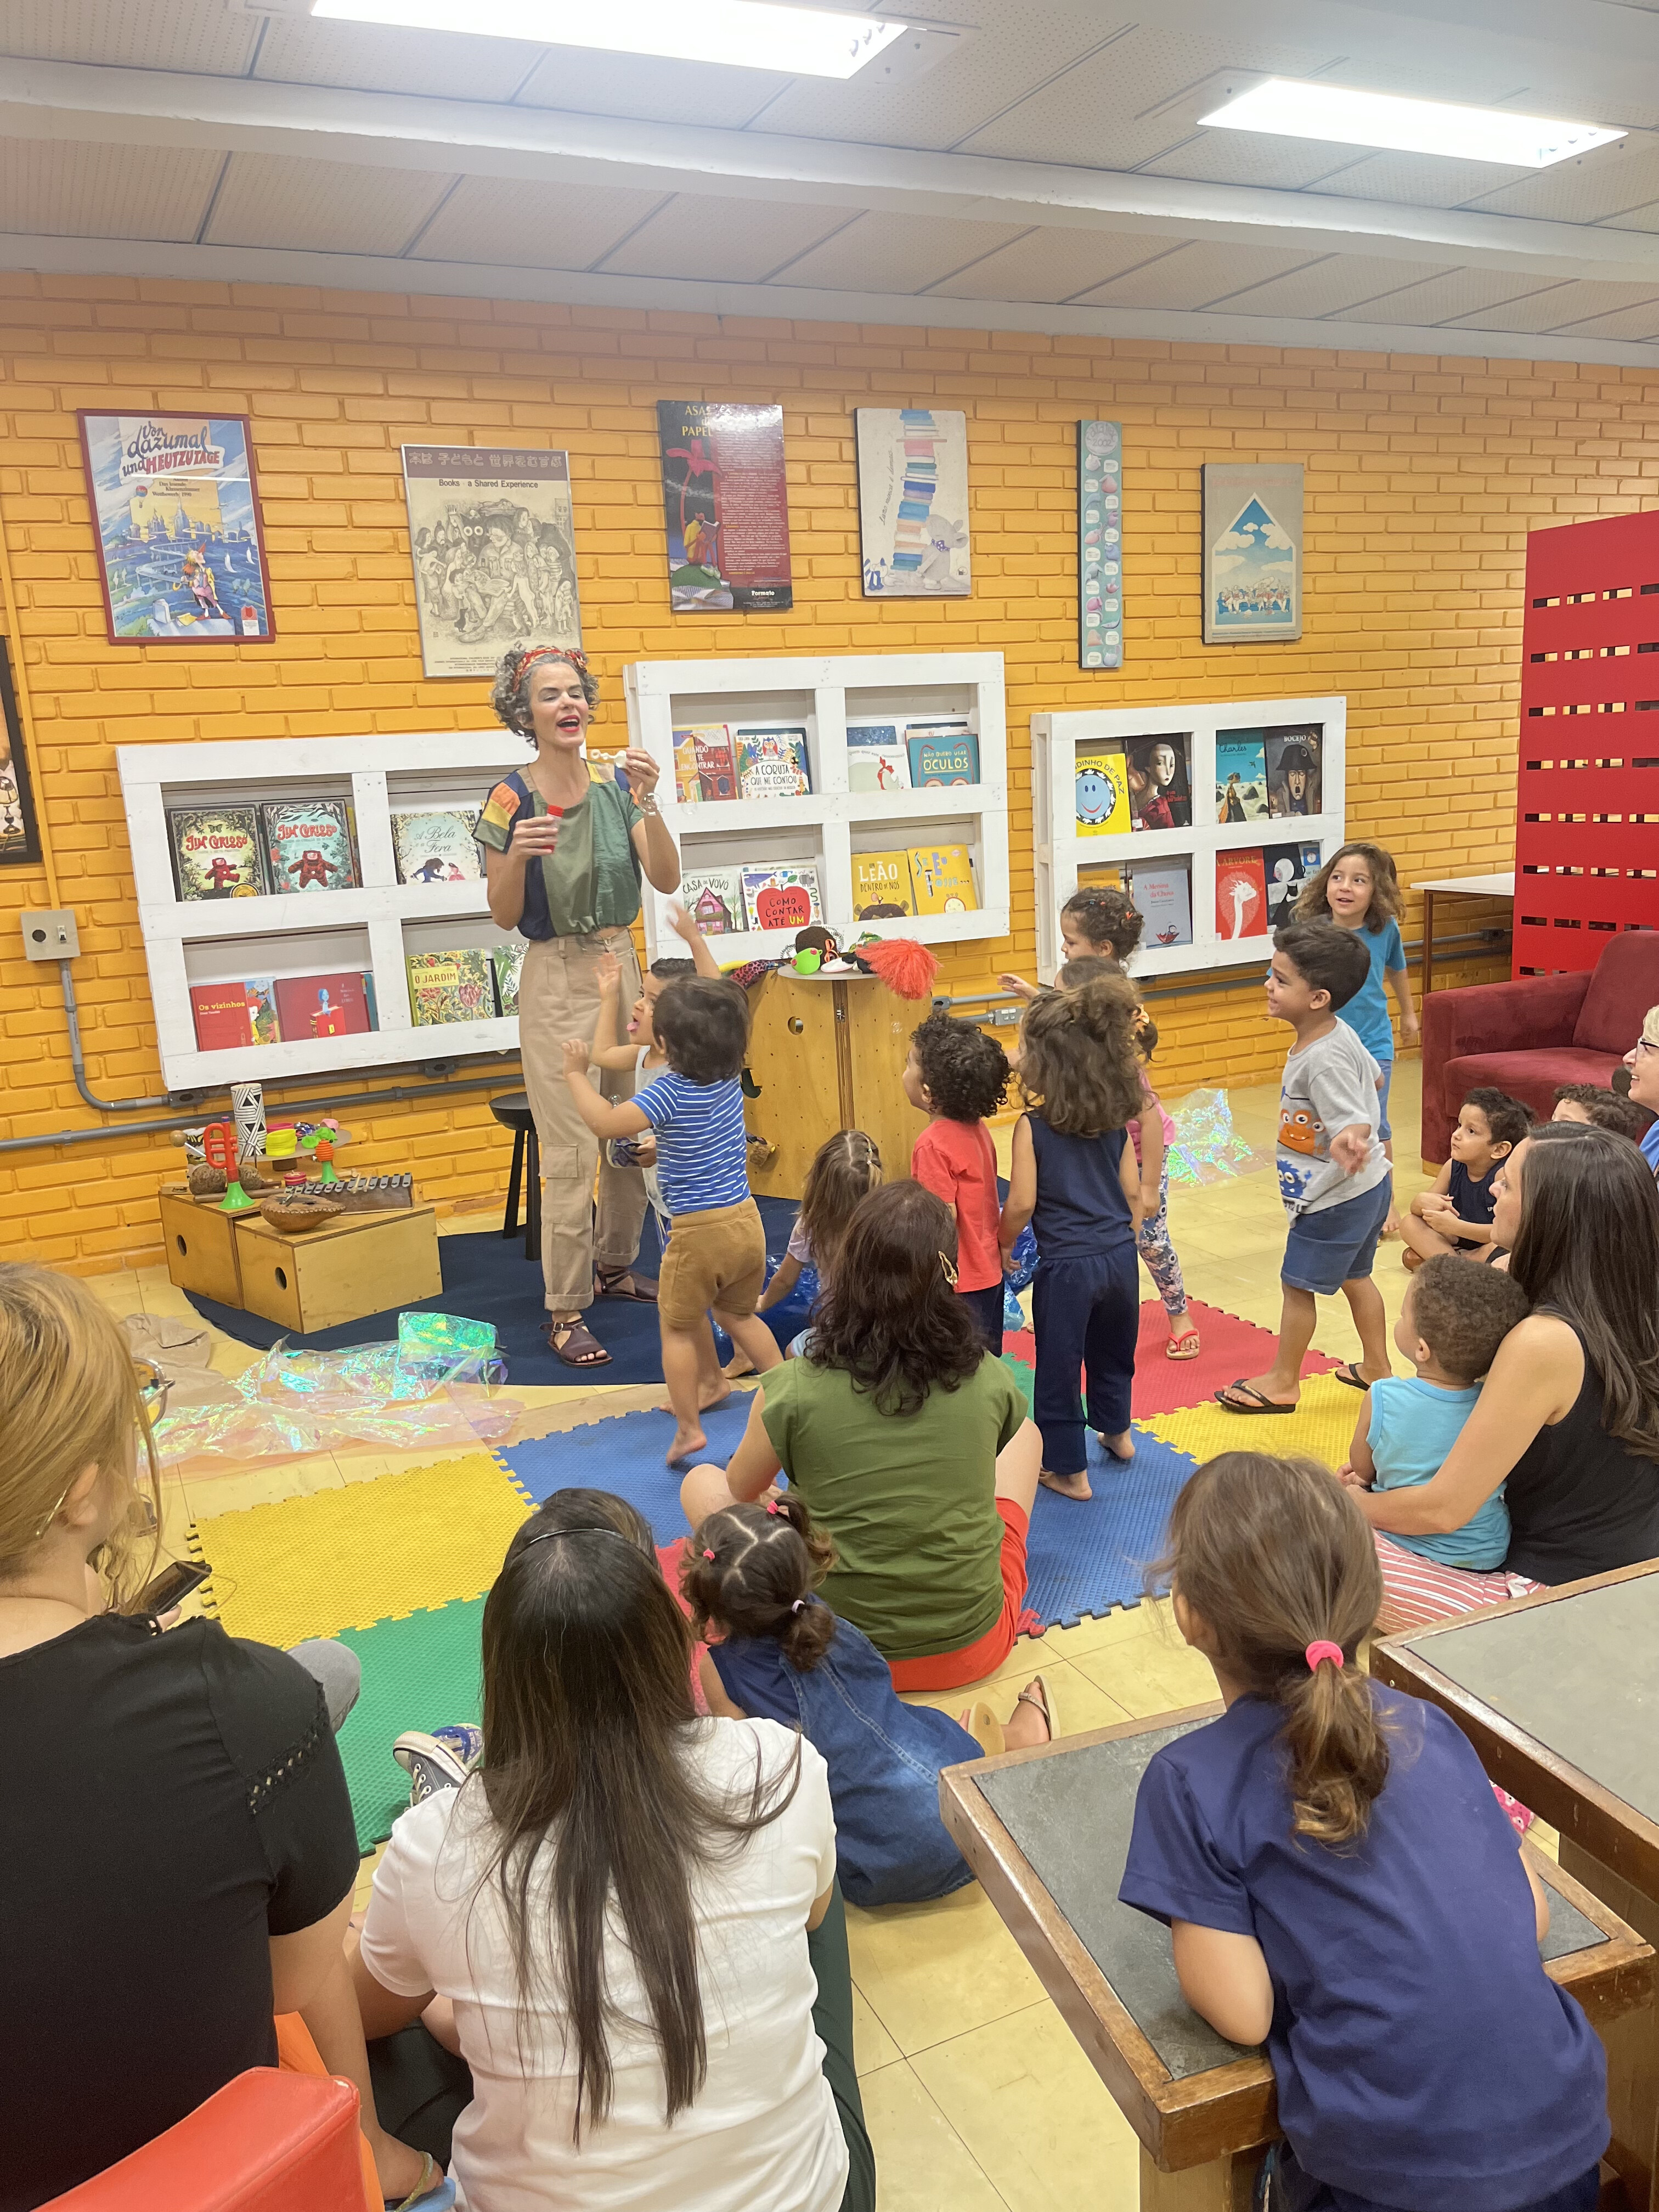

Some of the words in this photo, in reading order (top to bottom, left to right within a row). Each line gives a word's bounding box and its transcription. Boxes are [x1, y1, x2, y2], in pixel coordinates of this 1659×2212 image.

[143, 421, 167, 439] Von
[682, 426, 713, 437] PAPEL
[127, 425, 214, 459] dazumal
[122, 455, 149, 477] und
[146, 450, 220, 475] HEUTZUTAGE
[409, 452, 432, 465] 本は
[438, 453, 484, 466] 子どもと
[489, 454, 562, 467] 世界をむすぶ
[501, 481, 538, 489] Experience
[683, 745, 708, 755] QUANDO
[1219, 742, 1247, 753] Charles
[681, 761, 715, 770] ENCONTRAR
[756, 765, 760, 775] A
[761, 765, 789, 775] CORUJA
[923, 757, 968, 771] ÓCULOS
[751, 777, 761, 786] QUE
[764, 777, 771, 785] ME
[774, 776, 797, 785] CONTOU
[1104, 764, 1115, 775] DE
[1114, 775, 1125, 794] PAZ
[277, 824, 298, 840] JIM
[414, 831, 425, 840] A
[425, 826, 456, 839] Bela
[186, 835, 207, 851] JIM
[425, 839, 452, 853] Fera
[858, 861, 898, 882] LEÃO
[683, 879, 702, 894] CASA
[709, 878, 729, 890] VOVÓ
[860, 883, 883, 893] DENTRO
[770, 898, 796, 907] COMO
[766, 905, 804, 917] CONTAR
[769, 917, 785, 927] ATÉ
[789, 915, 804, 925] UM
[415, 975, 420, 984] O
[423, 973, 456, 983] JARDIM
[211, 1001, 245, 1009] vizinhos
